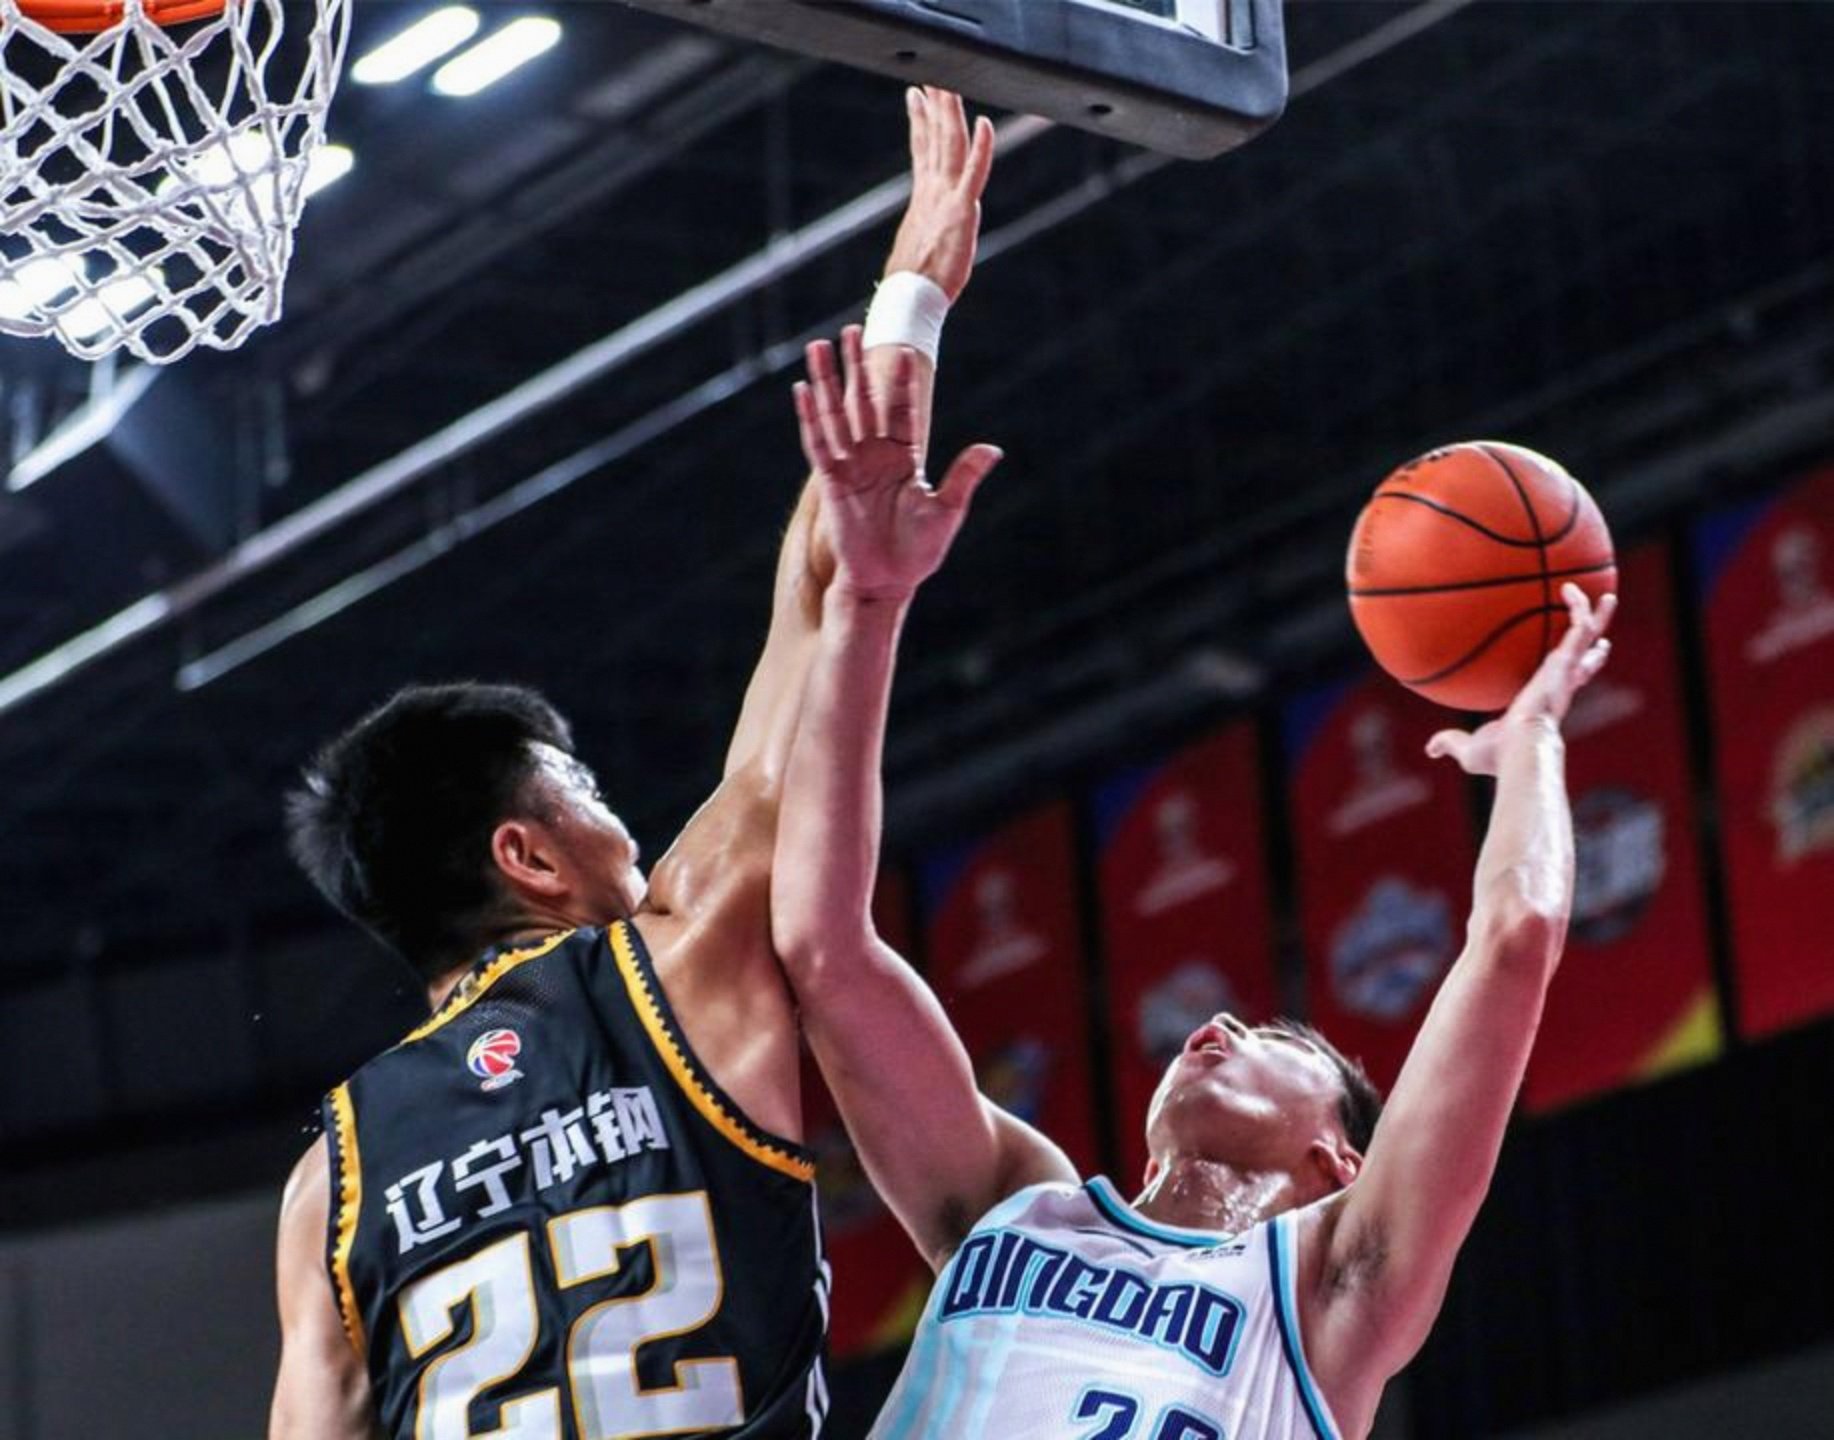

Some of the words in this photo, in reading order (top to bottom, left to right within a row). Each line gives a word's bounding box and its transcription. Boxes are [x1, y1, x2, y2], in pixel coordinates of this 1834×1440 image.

[384, 1085, 670, 1255] 辽宁本钢
[399, 1189, 746, 1440] 22
[938, 1229, 1247, 1378] QINGDAO
